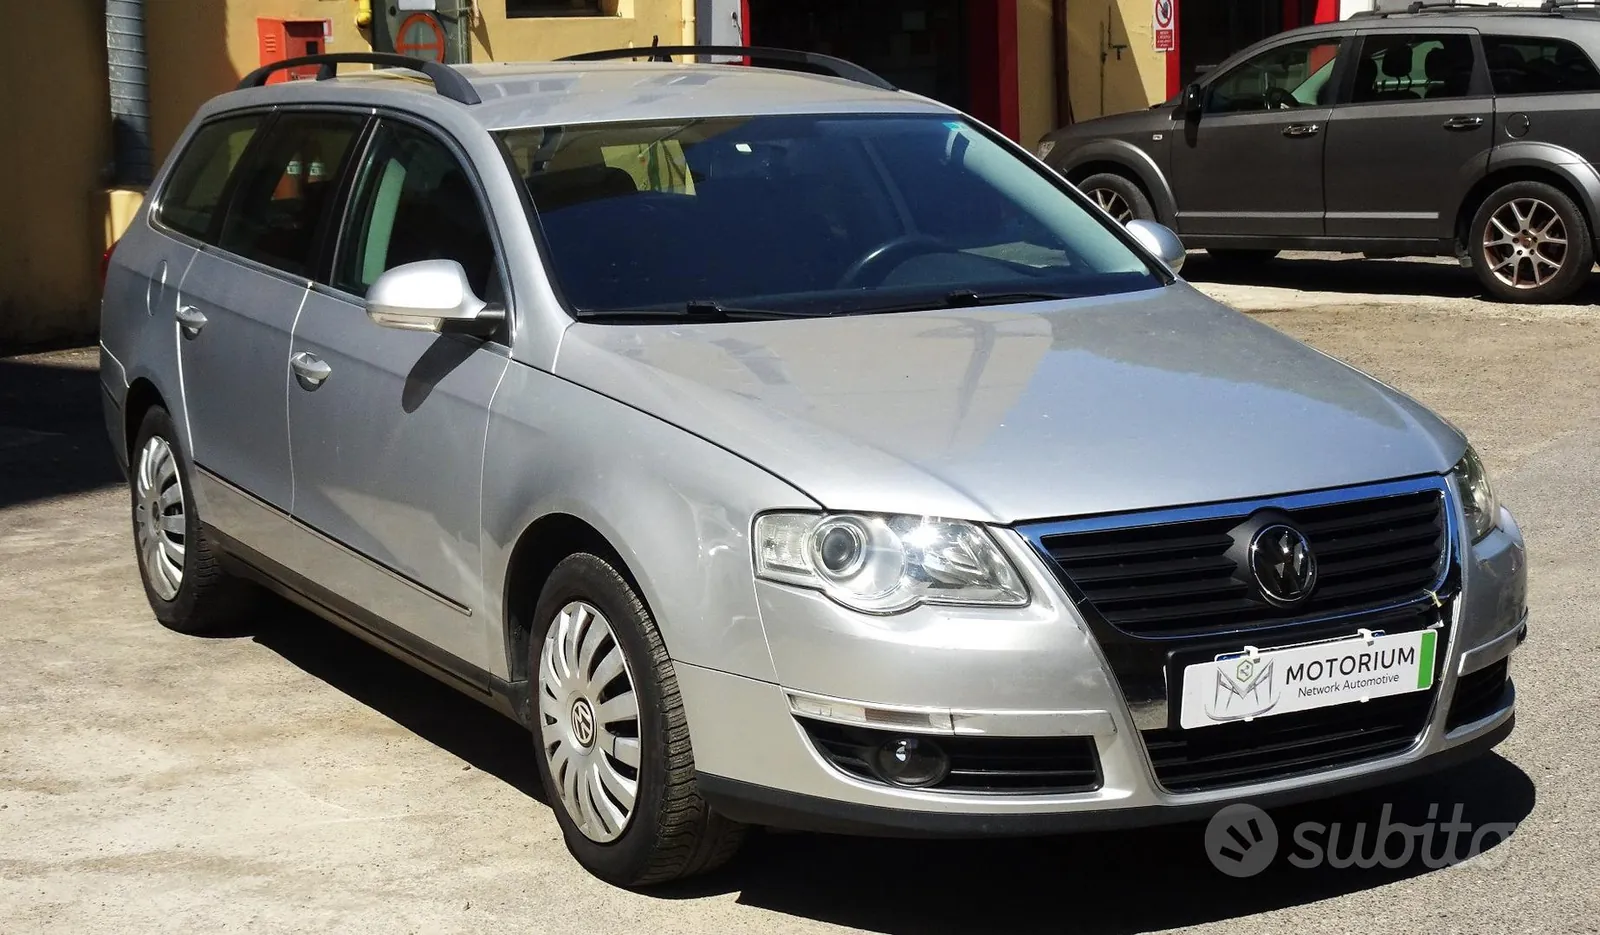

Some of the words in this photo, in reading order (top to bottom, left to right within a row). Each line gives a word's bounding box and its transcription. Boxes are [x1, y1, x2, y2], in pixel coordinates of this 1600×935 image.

[1286, 646, 1415, 685] MOTORIUM
[1298, 681, 1340, 698] Network
[1343, 673, 1400, 690] Automotive
